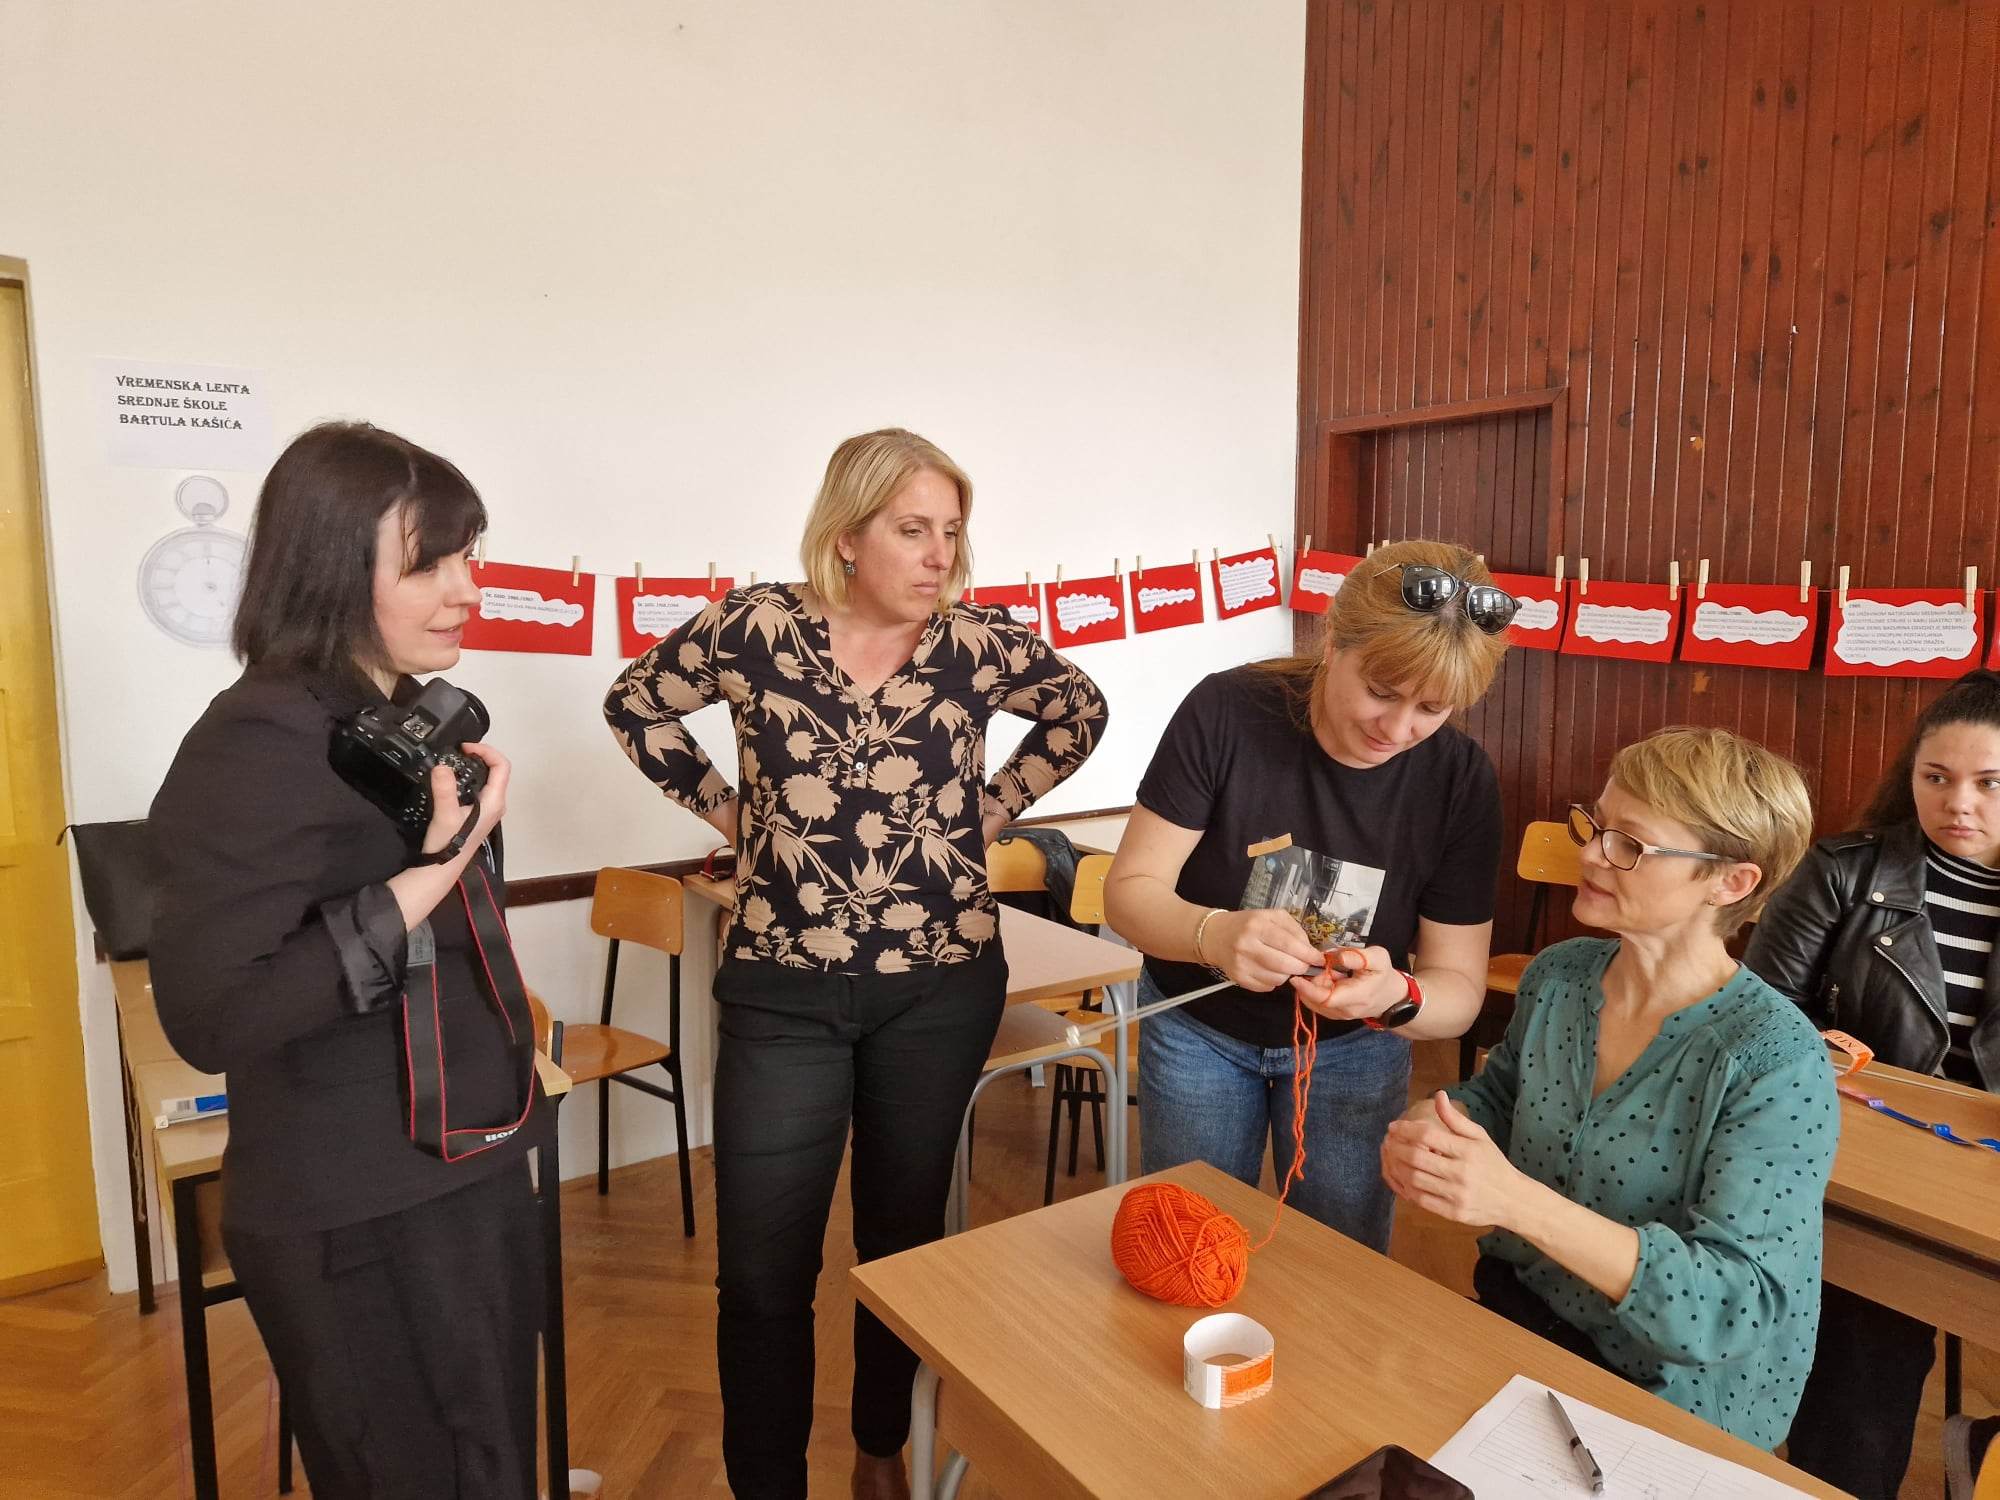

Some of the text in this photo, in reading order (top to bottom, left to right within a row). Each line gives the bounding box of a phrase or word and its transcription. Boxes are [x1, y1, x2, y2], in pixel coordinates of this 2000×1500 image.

[115, 375, 251, 395] VREMENSKA LENTA
[117, 395, 228, 411] SREDNJE ŠKOLE
[119, 414, 243, 430] BARTULA KAŠIĆA
